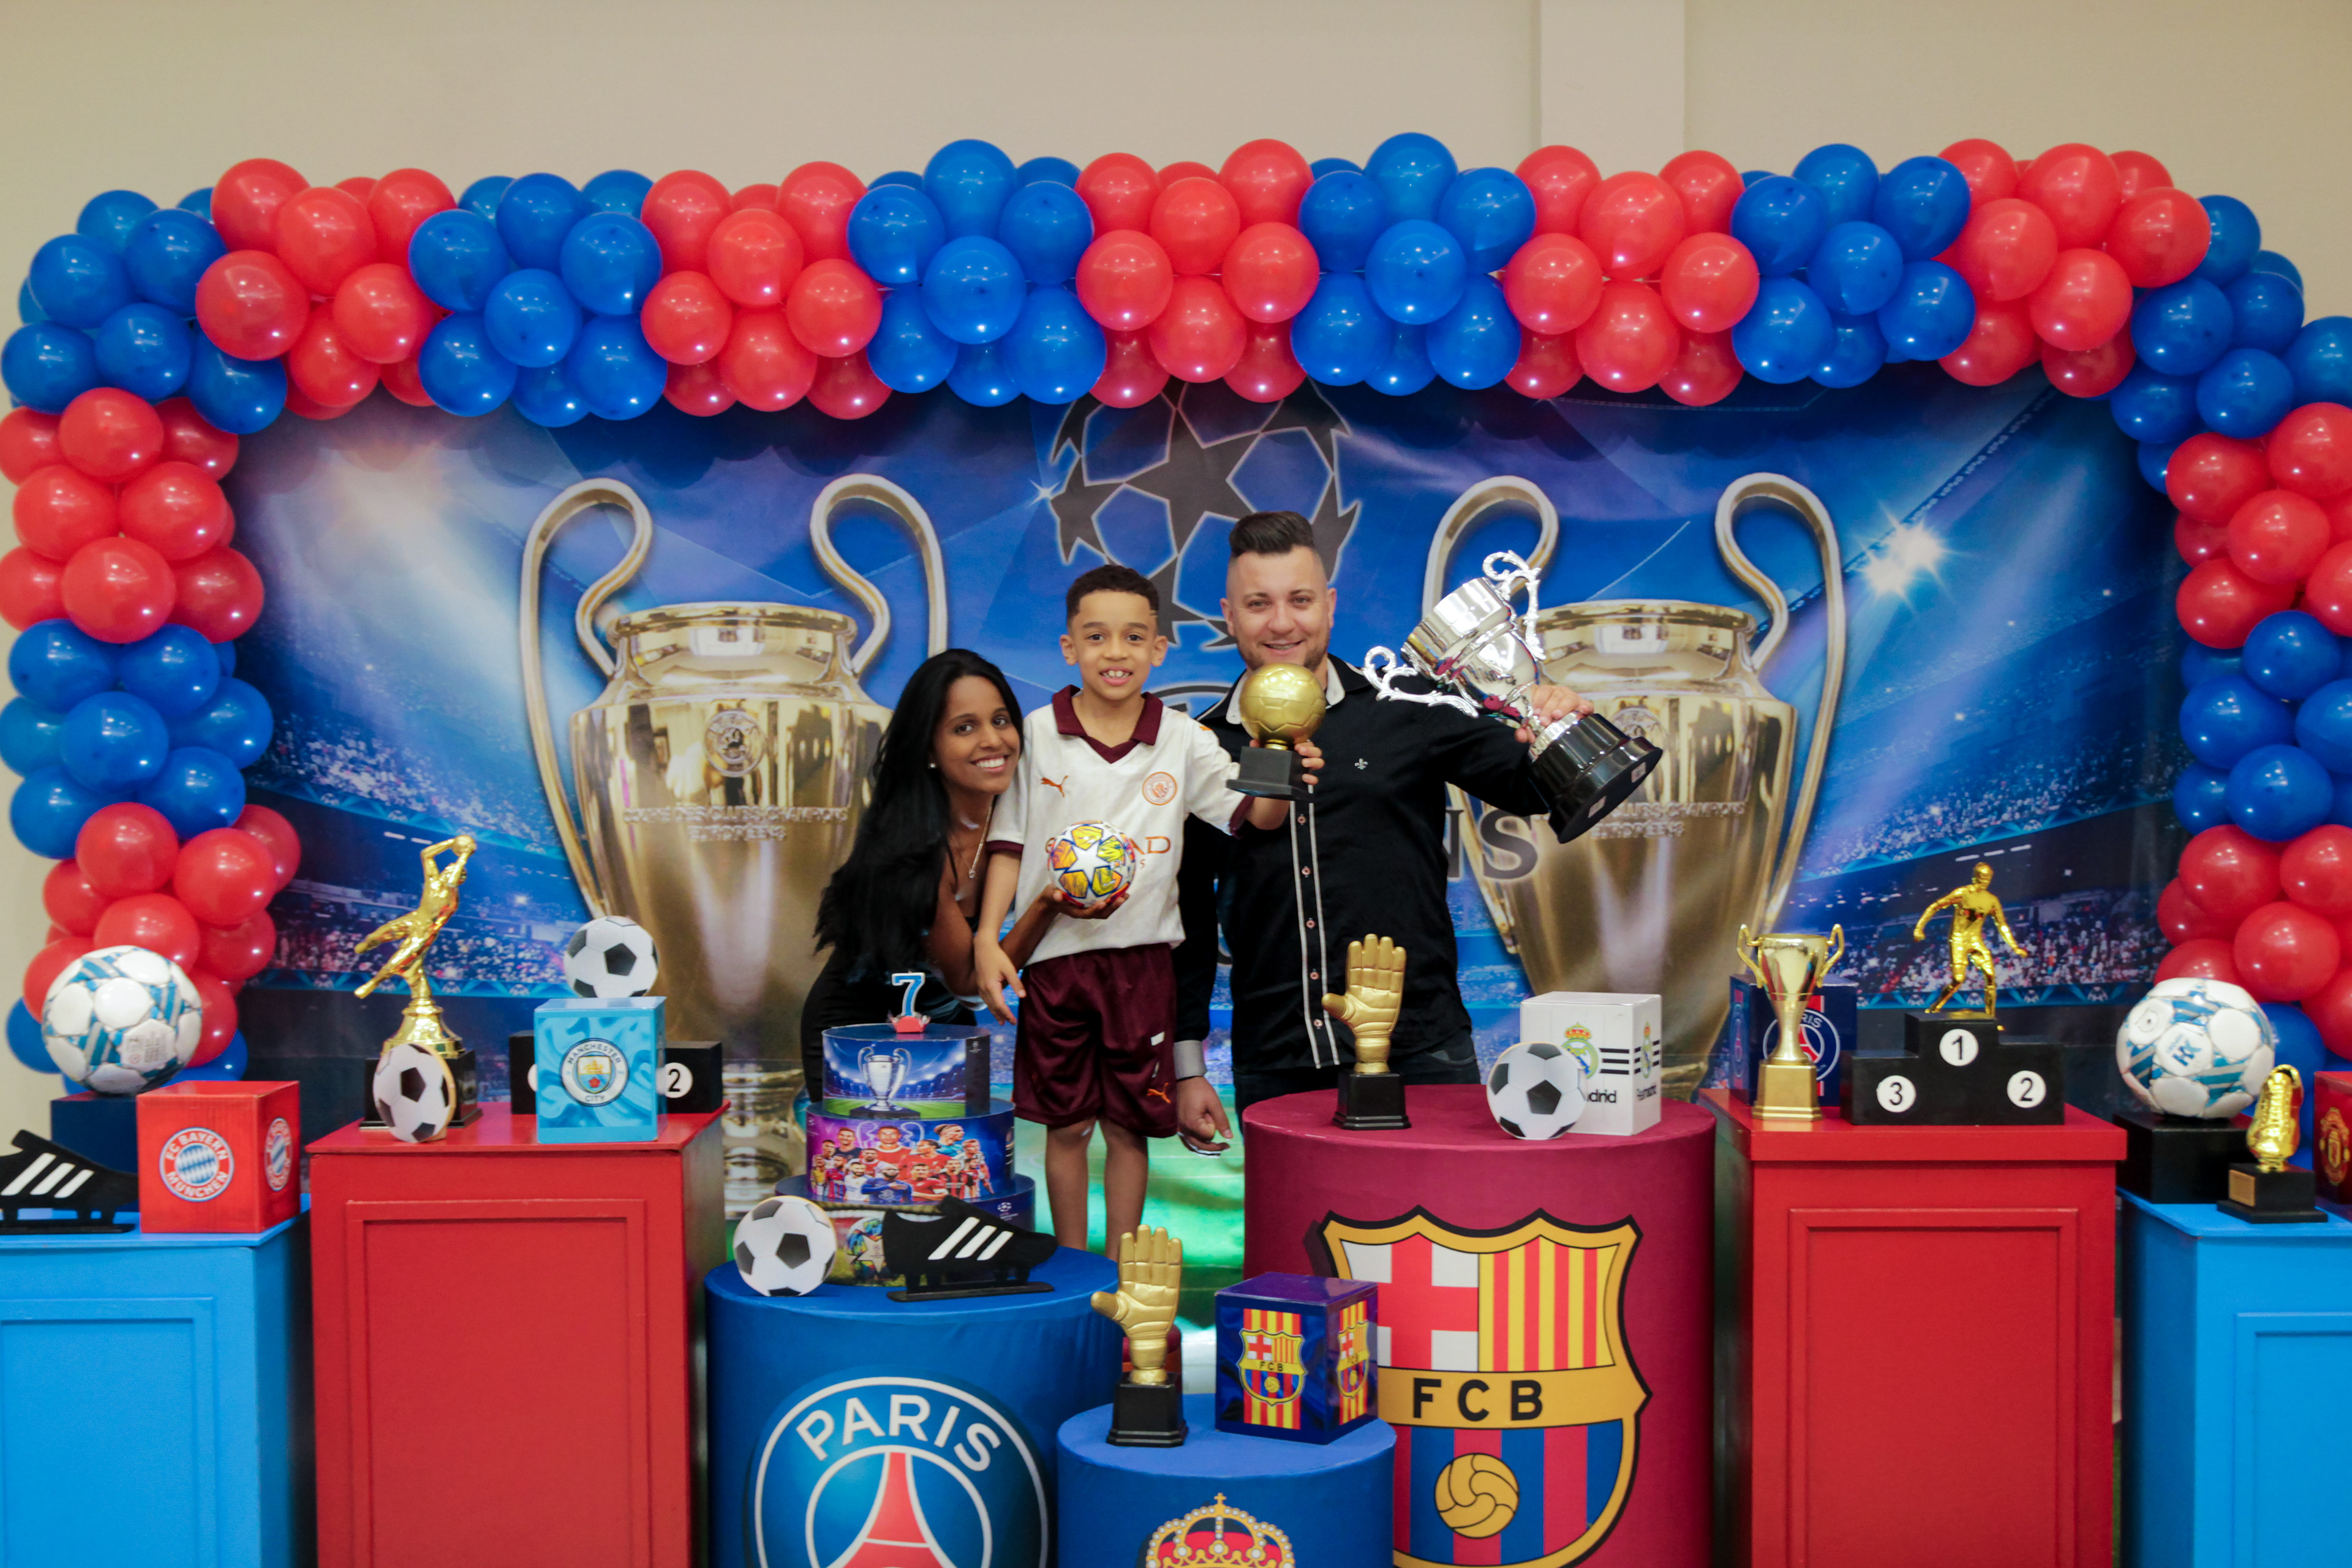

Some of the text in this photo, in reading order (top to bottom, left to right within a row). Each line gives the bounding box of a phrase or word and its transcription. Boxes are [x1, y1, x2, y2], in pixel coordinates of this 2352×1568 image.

[892, 972, 925, 1017] 7
[567, 1043, 621, 1065] MANCHESTER
[1951, 1035, 1963, 1060] 1
[668, 1068, 680, 1092] 2
[2019, 1077, 2034, 1102] 2
[1888, 1082, 1903, 1106] 3
[165, 1132, 228, 1161] FC BAYERN
[1259, 1361, 1284, 1372] FCB
[1413, 1377, 1543, 1422] FCB
[796, 1394, 1001, 1472] PARIS
